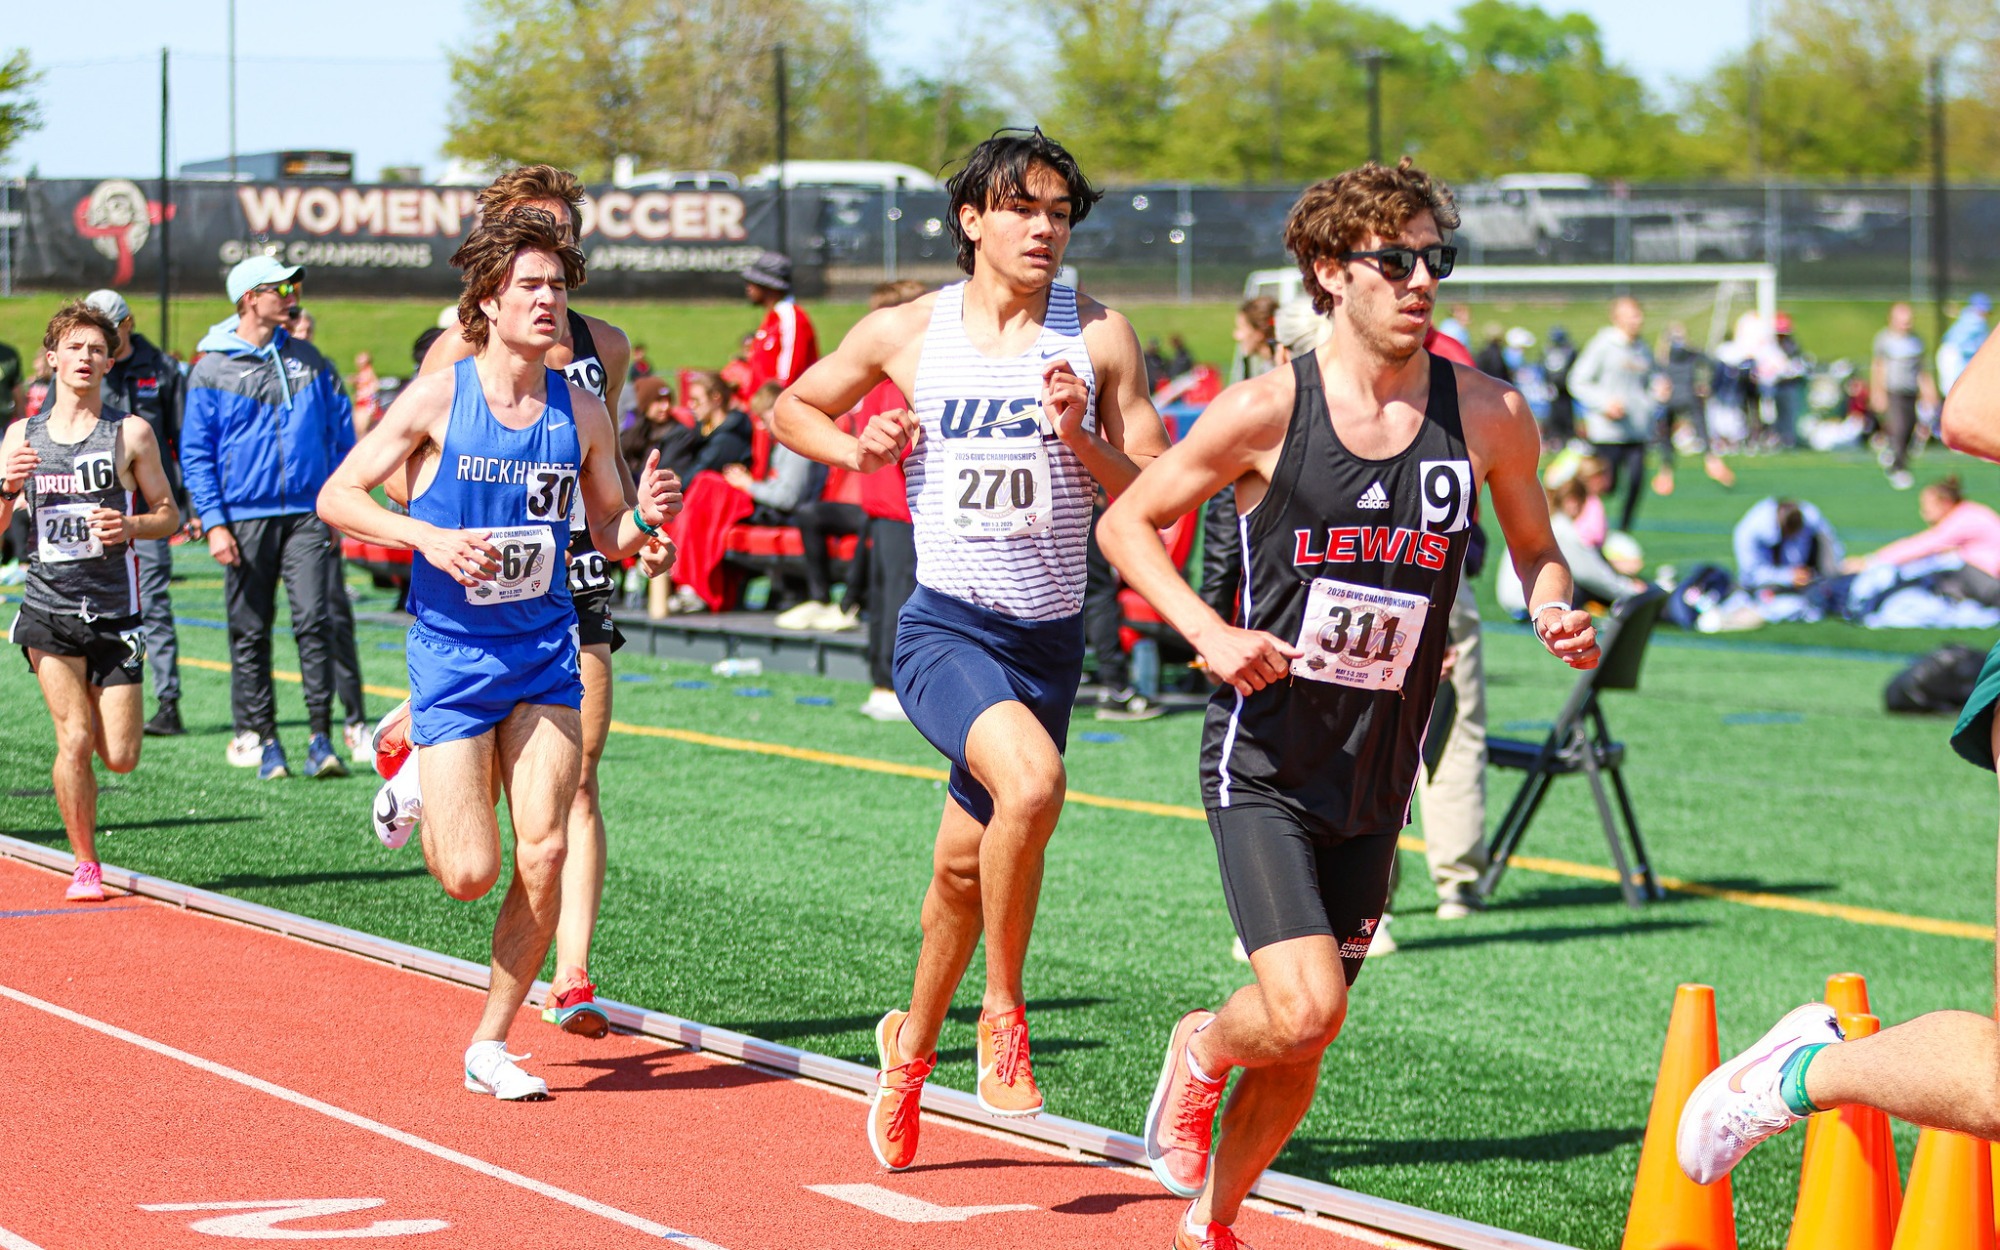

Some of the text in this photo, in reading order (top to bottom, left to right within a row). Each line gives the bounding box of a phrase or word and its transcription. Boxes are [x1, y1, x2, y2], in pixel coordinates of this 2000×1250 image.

[238, 184, 746, 242] WOMEN' CCER
[569, 364, 605, 397] 19
[940, 398, 1042, 439] UIS
[456, 454, 575, 485] ROCKH
[955, 453, 969, 461] 2025
[986, 452, 1037, 461] CHAMPIONSHIPS
[34, 474, 86, 495] DRU
[76, 458, 113, 491] 16
[958, 468, 1034, 510] 270
[528, 472, 575, 520] 30
[1356, 499, 1390, 510] adidas
[1424, 465, 1461, 533] 9
[46, 515, 90, 545] 246
[504, 528, 543, 538] CHAMPIONSHIPS
[480, 543, 542, 581] 67
[1293, 526, 1450, 571] LEWIS
[570, 555, 611, 589] 19
[1327, 586, 1416, 610] 2025 GLVC CHAMPIONSHIPS
[1321, 605, 1401, 662] 311
[1339, 950, 1367, 959] OUNT
[1341, 943, 1370, 951] CROS
